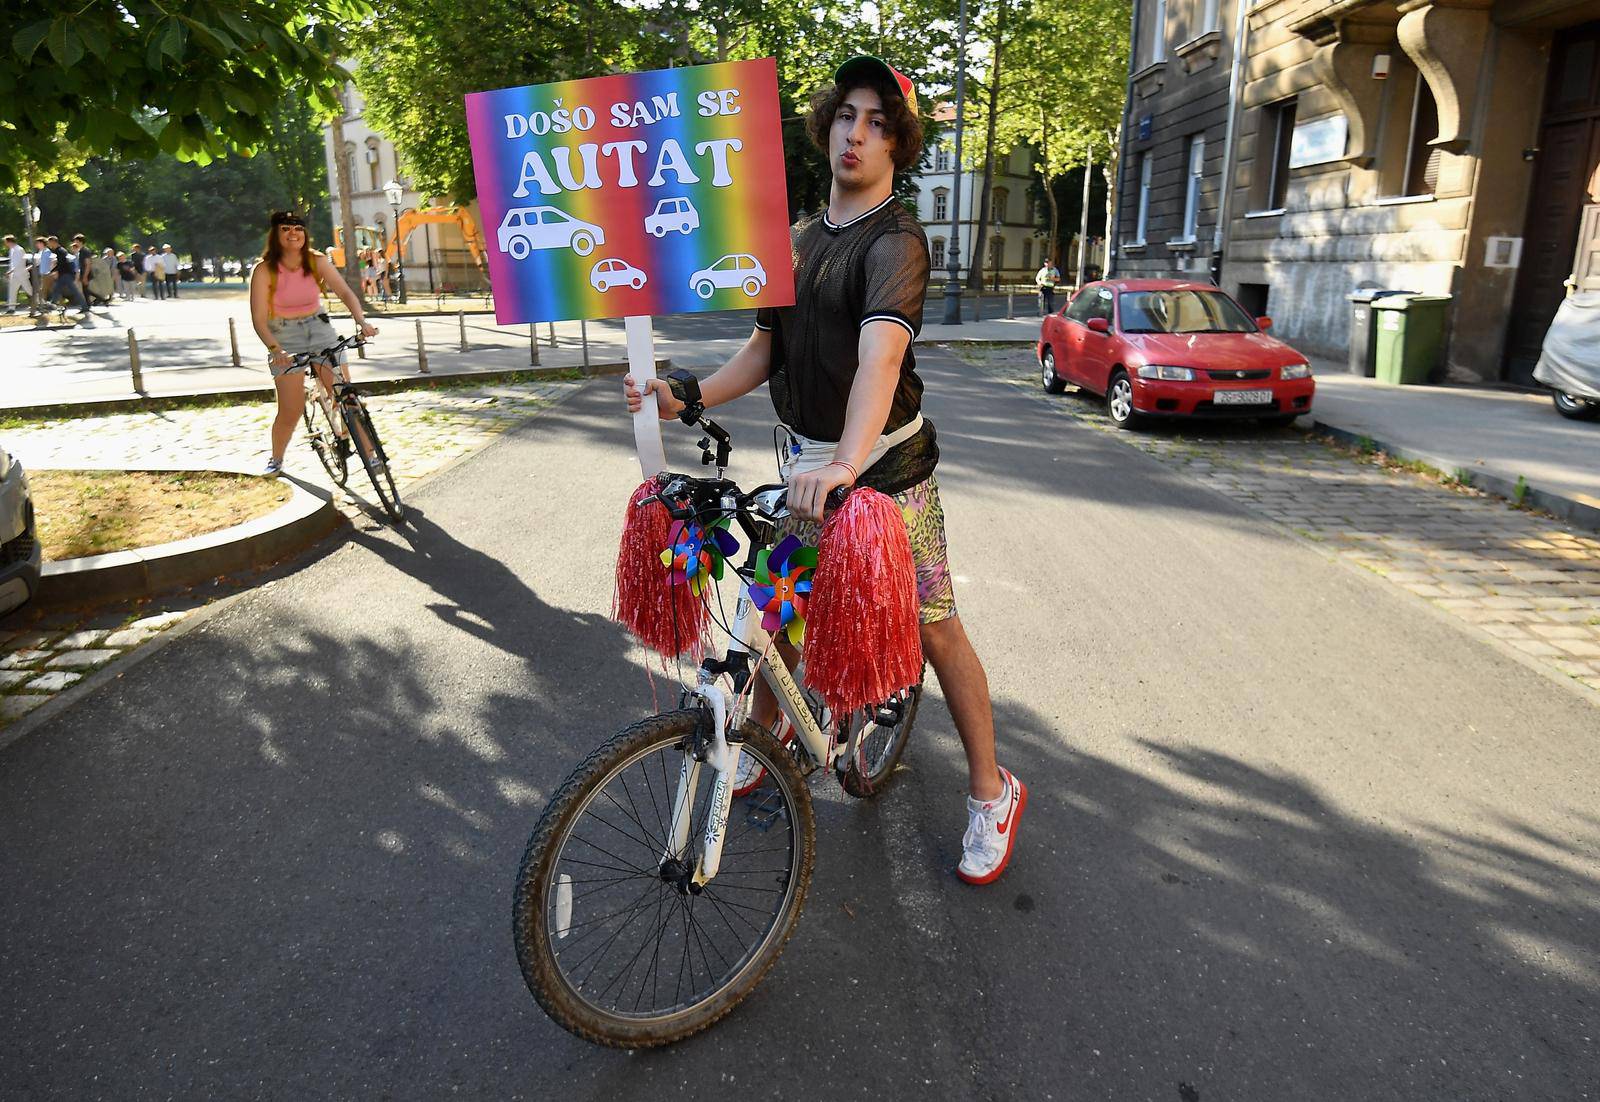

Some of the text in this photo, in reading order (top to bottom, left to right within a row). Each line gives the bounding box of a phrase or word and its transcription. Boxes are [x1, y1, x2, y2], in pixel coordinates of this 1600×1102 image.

[504, 88, 742, 139] DOŠO SAM SE
[512, 138, 743, 198] AUTAT
[712, 780, 726, 816] SUNTOUR
